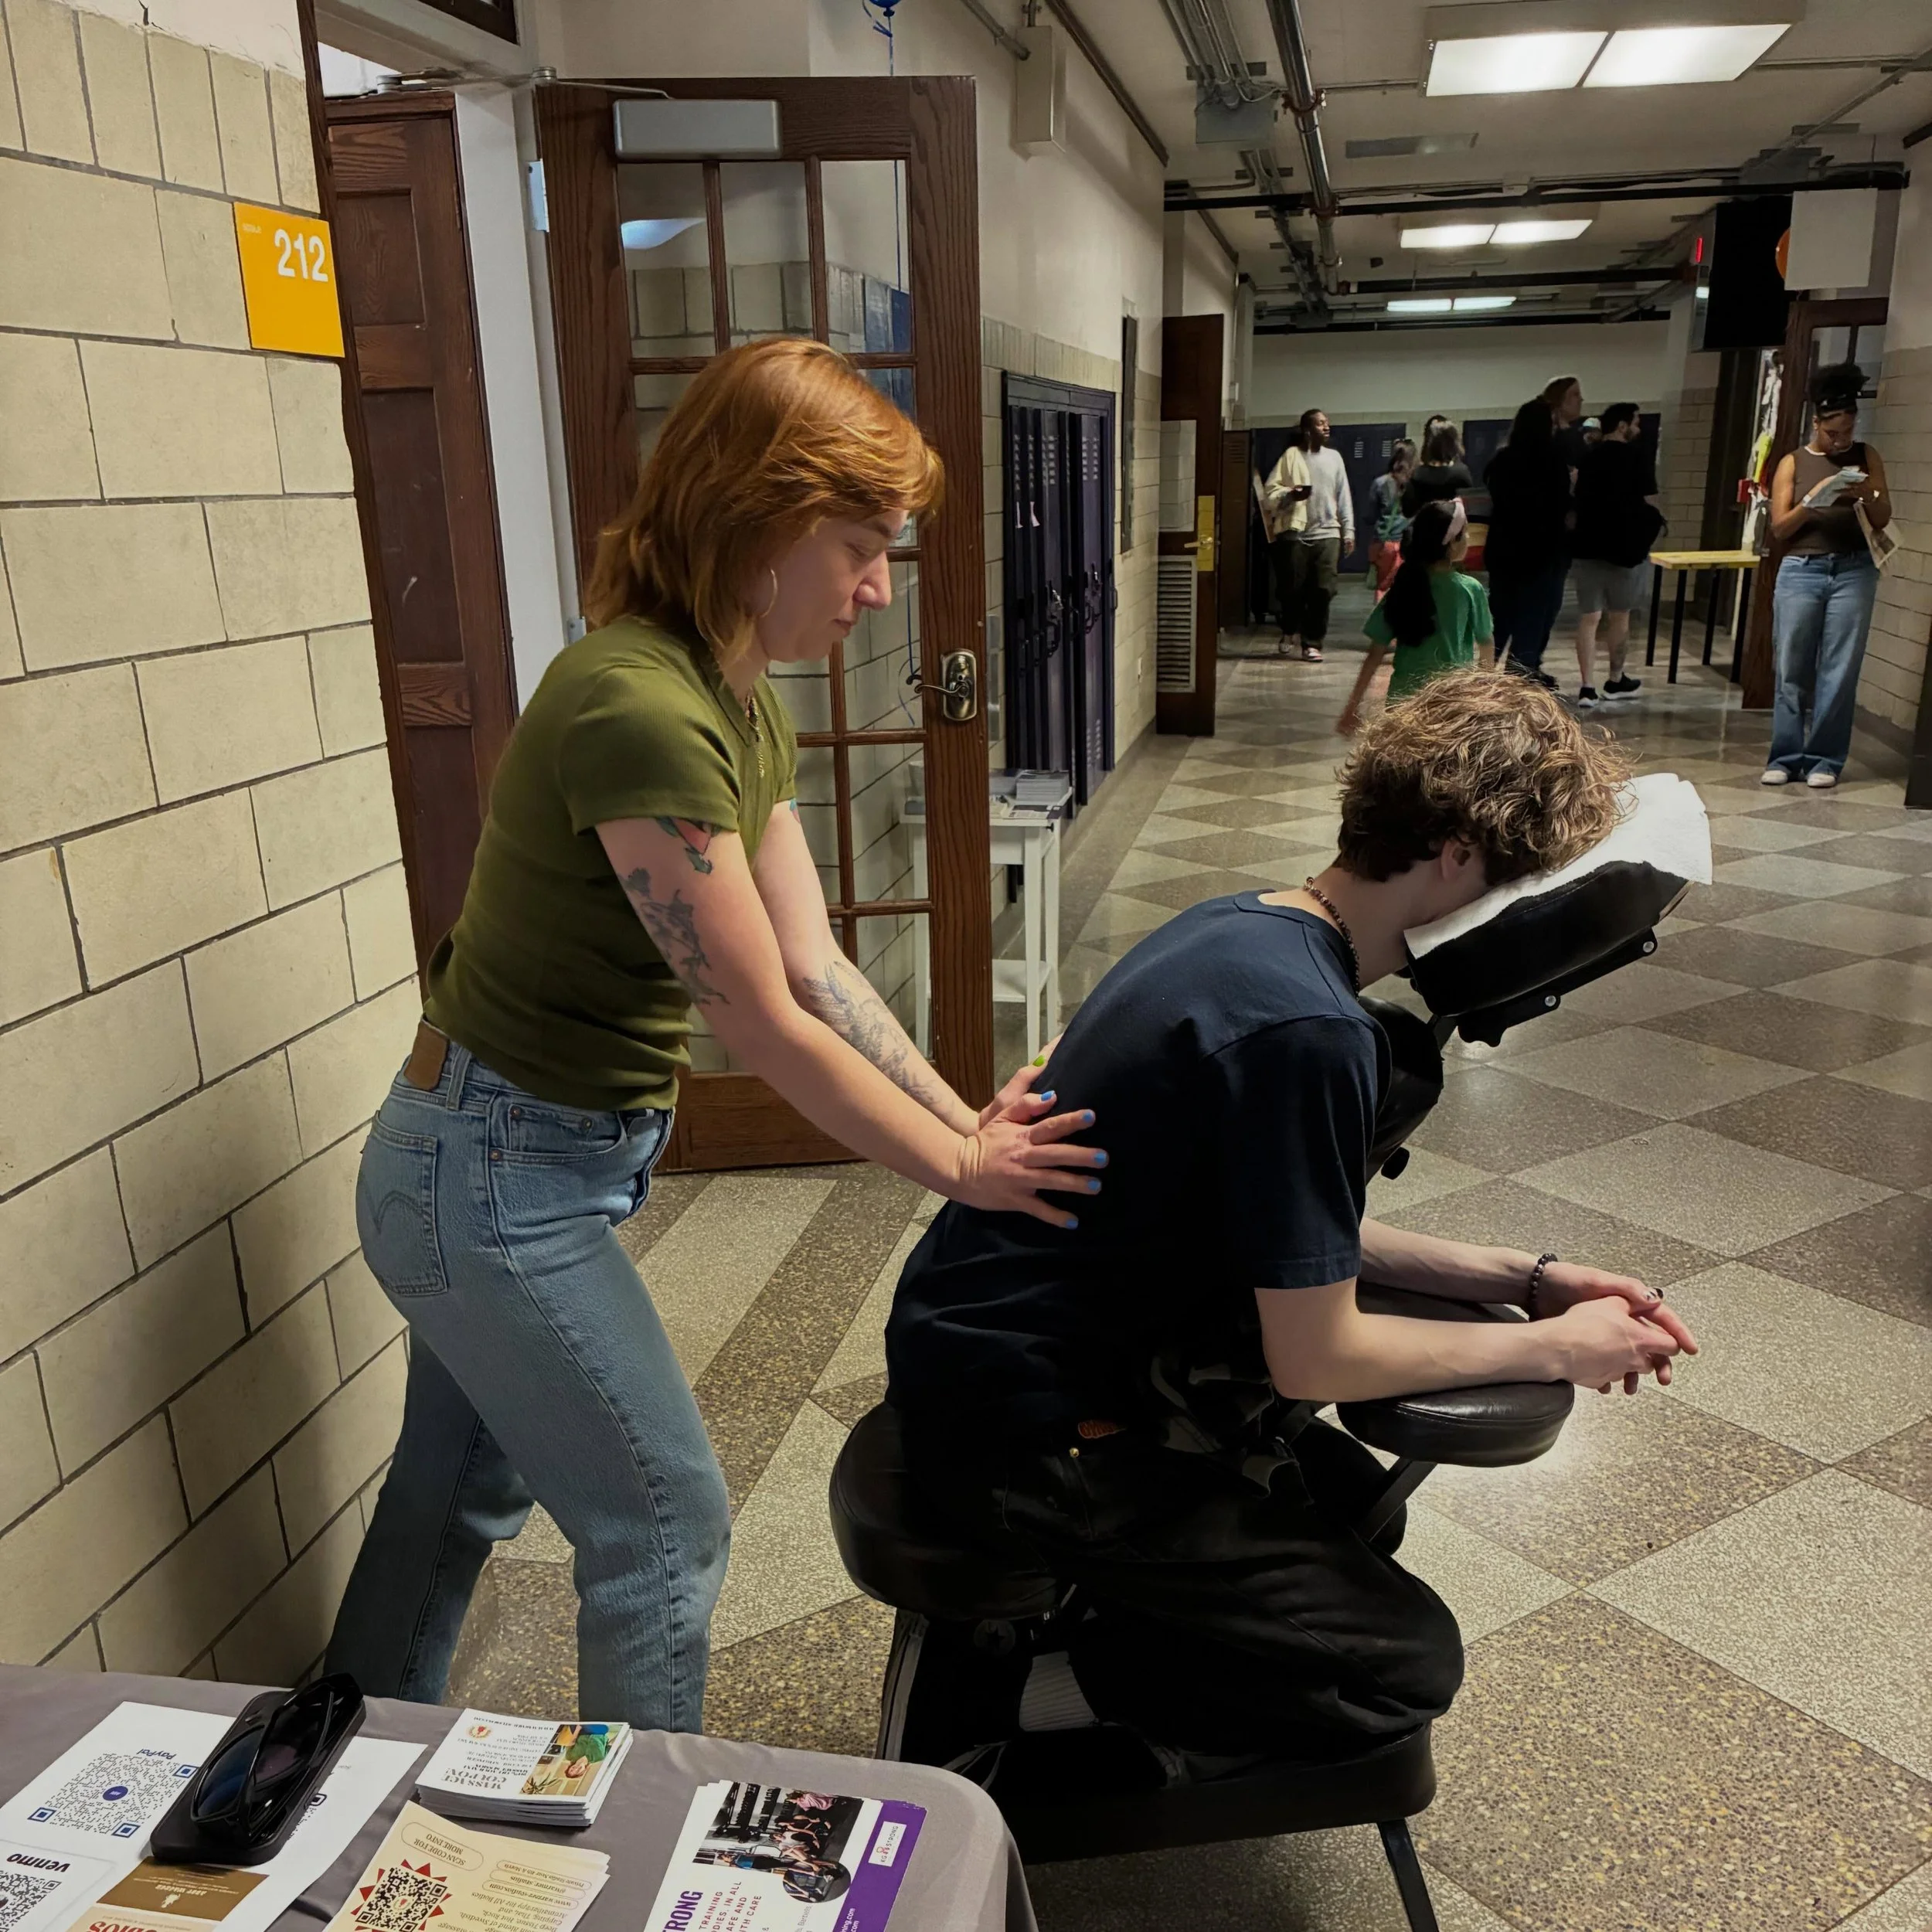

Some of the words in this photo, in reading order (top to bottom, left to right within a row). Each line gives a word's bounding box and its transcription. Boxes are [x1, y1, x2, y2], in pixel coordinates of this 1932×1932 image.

[274, 229, 328, 282] 212
[136, 1749, 177, 1760] PayPal
[426, 1833, 444, 1845] INFO
[886, 1825, 899, 1846] STRONG
[413, 1838, 430, 1849] FOR
[444, 1842, 464, 1855] MORE
[429, 1845, 447, 1858] CODE
[6, 1853, 70, 1872] venmo
[446, 1856, 466, 1866] SCAN
[471, 1892, 494, 1903] Bodies
[723, 1898, 733, 1906] IN
[730, 1881, 742, 1896] ALL
[516, 1902, 568, 1919] Aromatherapy
[699, 1891, 723, 1930] TRAINING
[734, 1896, 747, 1913] AND
[747, 1896, 762, 1917] CARE
[501, 1915, 515, 1923] Hot
